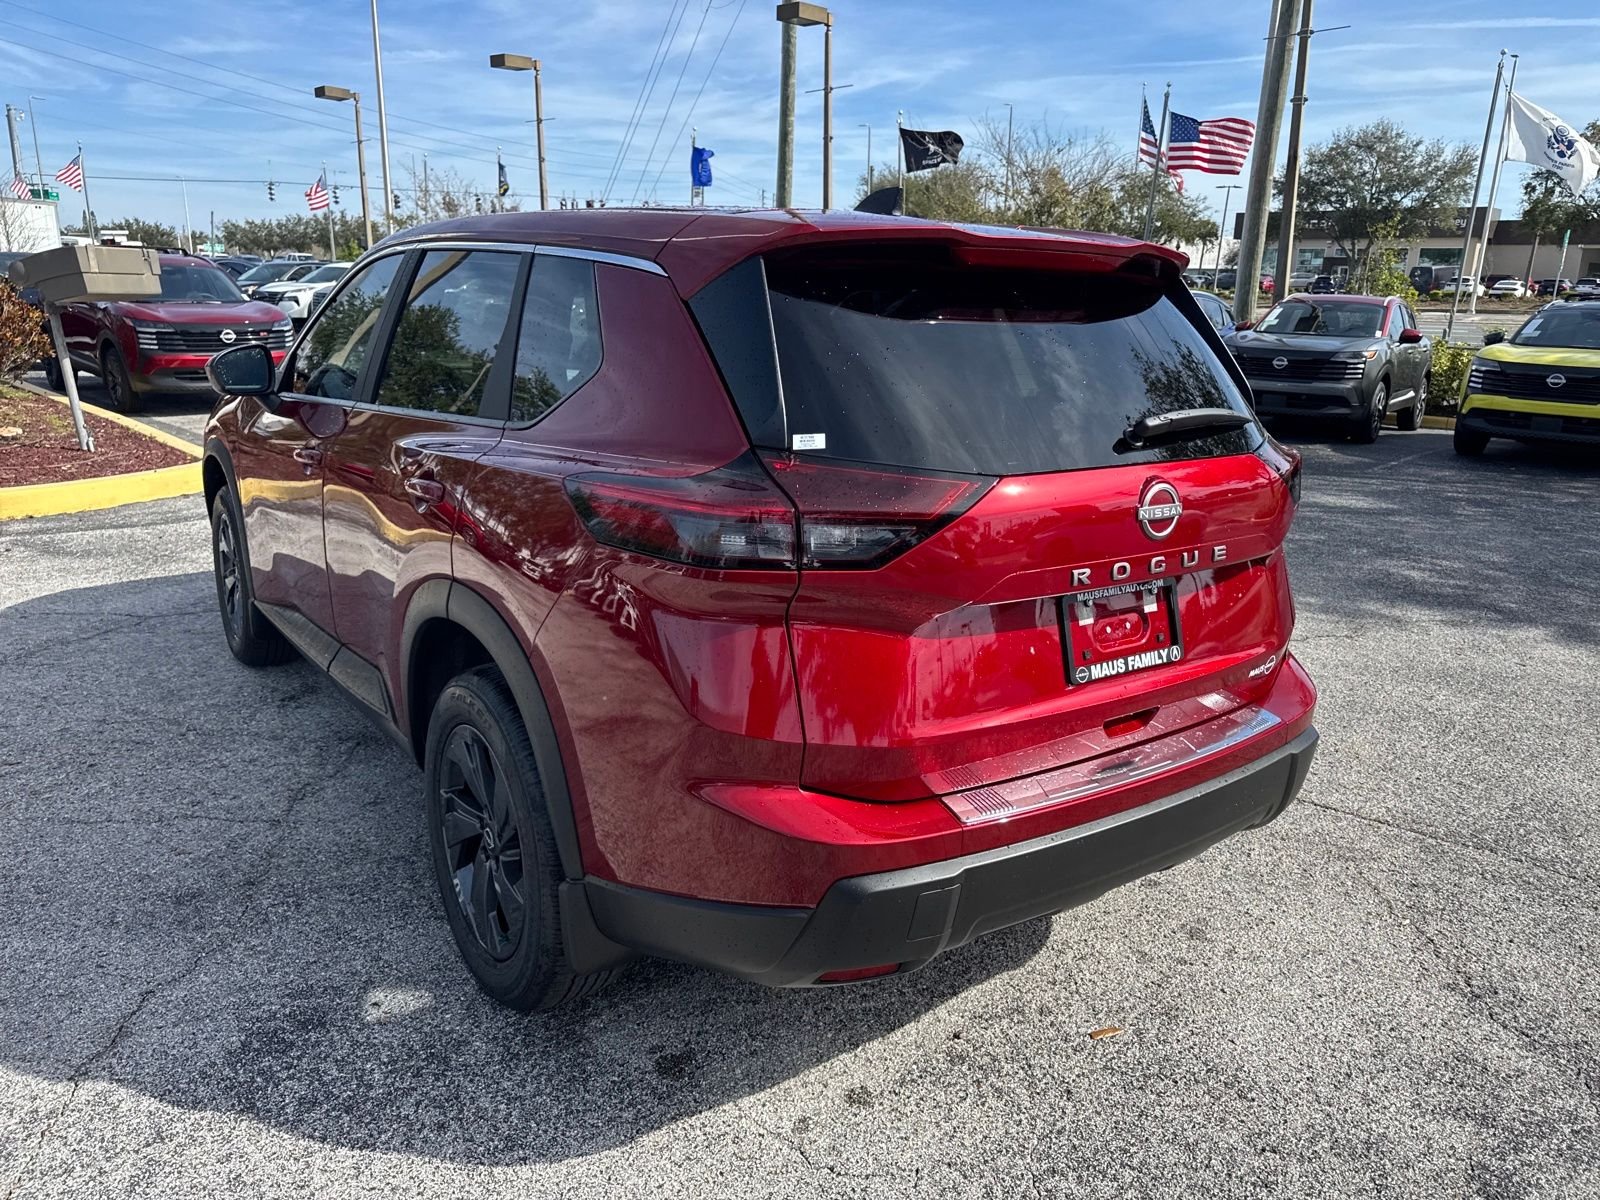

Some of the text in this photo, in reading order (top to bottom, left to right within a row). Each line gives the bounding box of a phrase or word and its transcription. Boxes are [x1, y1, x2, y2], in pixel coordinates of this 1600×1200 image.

[1140, 505, 1182, 518] NISSAN
[1072, 545, 1228, 587] ROGUE
[1091, 649, 1168, 680] MAUS FAMILY
